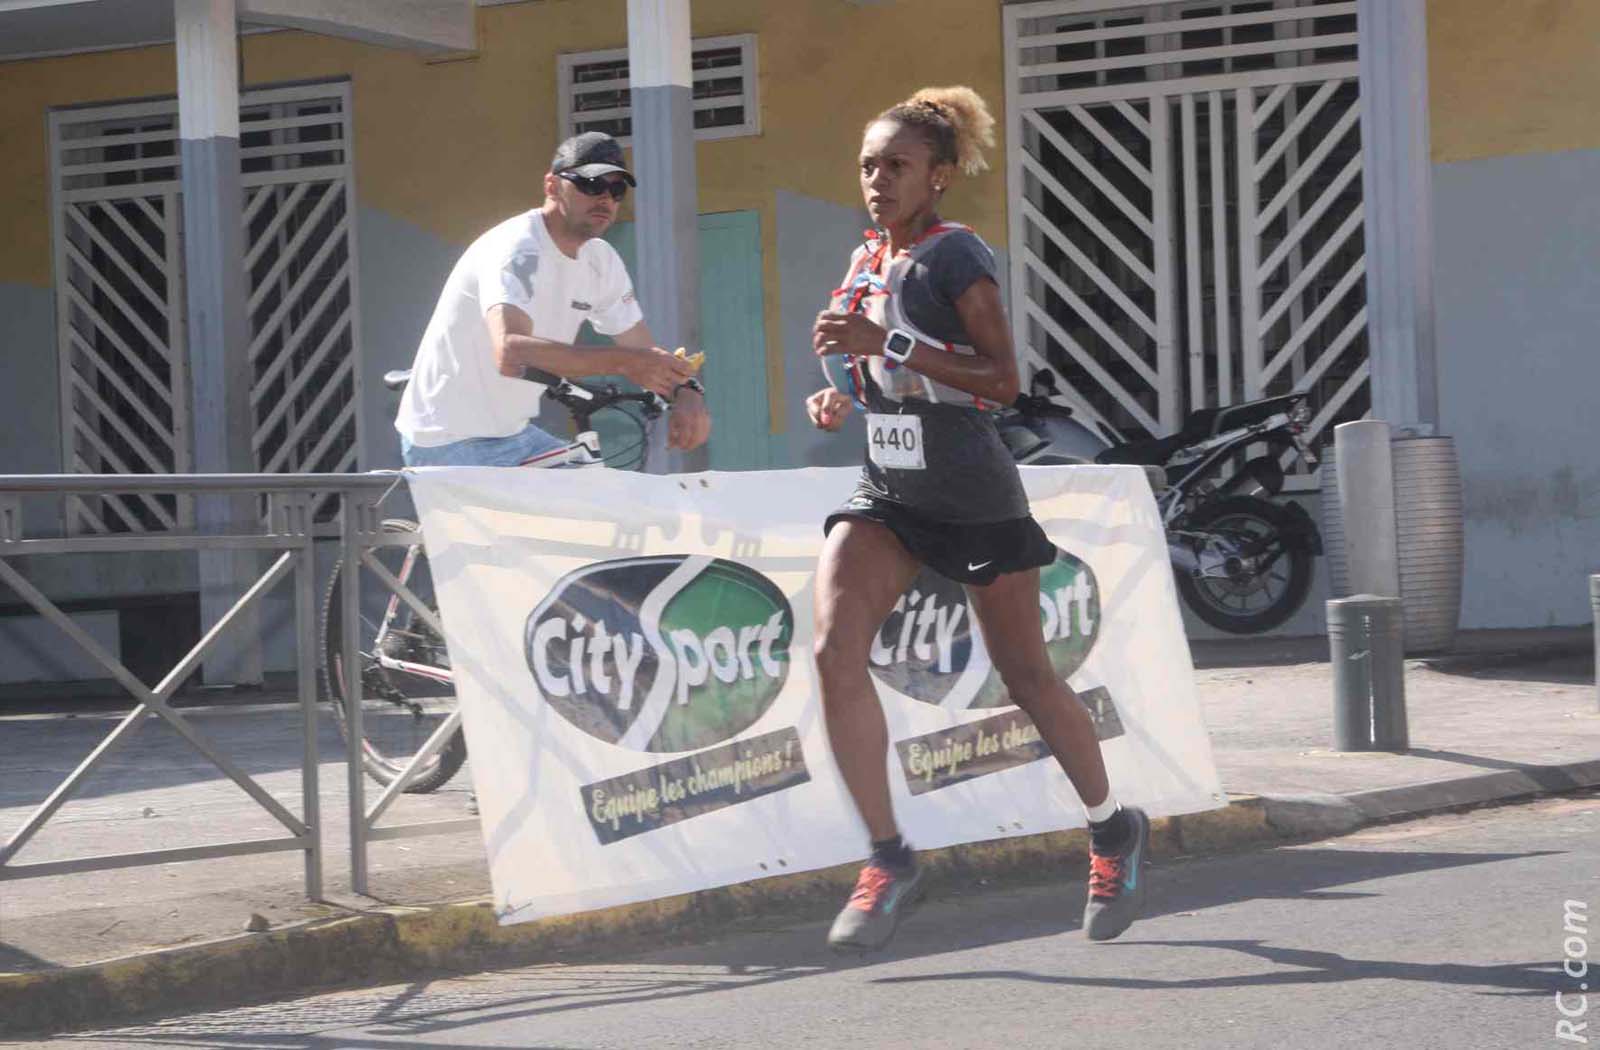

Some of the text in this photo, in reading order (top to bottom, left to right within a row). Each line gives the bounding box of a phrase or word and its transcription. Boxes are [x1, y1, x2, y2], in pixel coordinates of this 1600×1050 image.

[872, 426, 916, 452] 440
[976, 729, 999, 757] les
[660, 774, 686, 804] les
